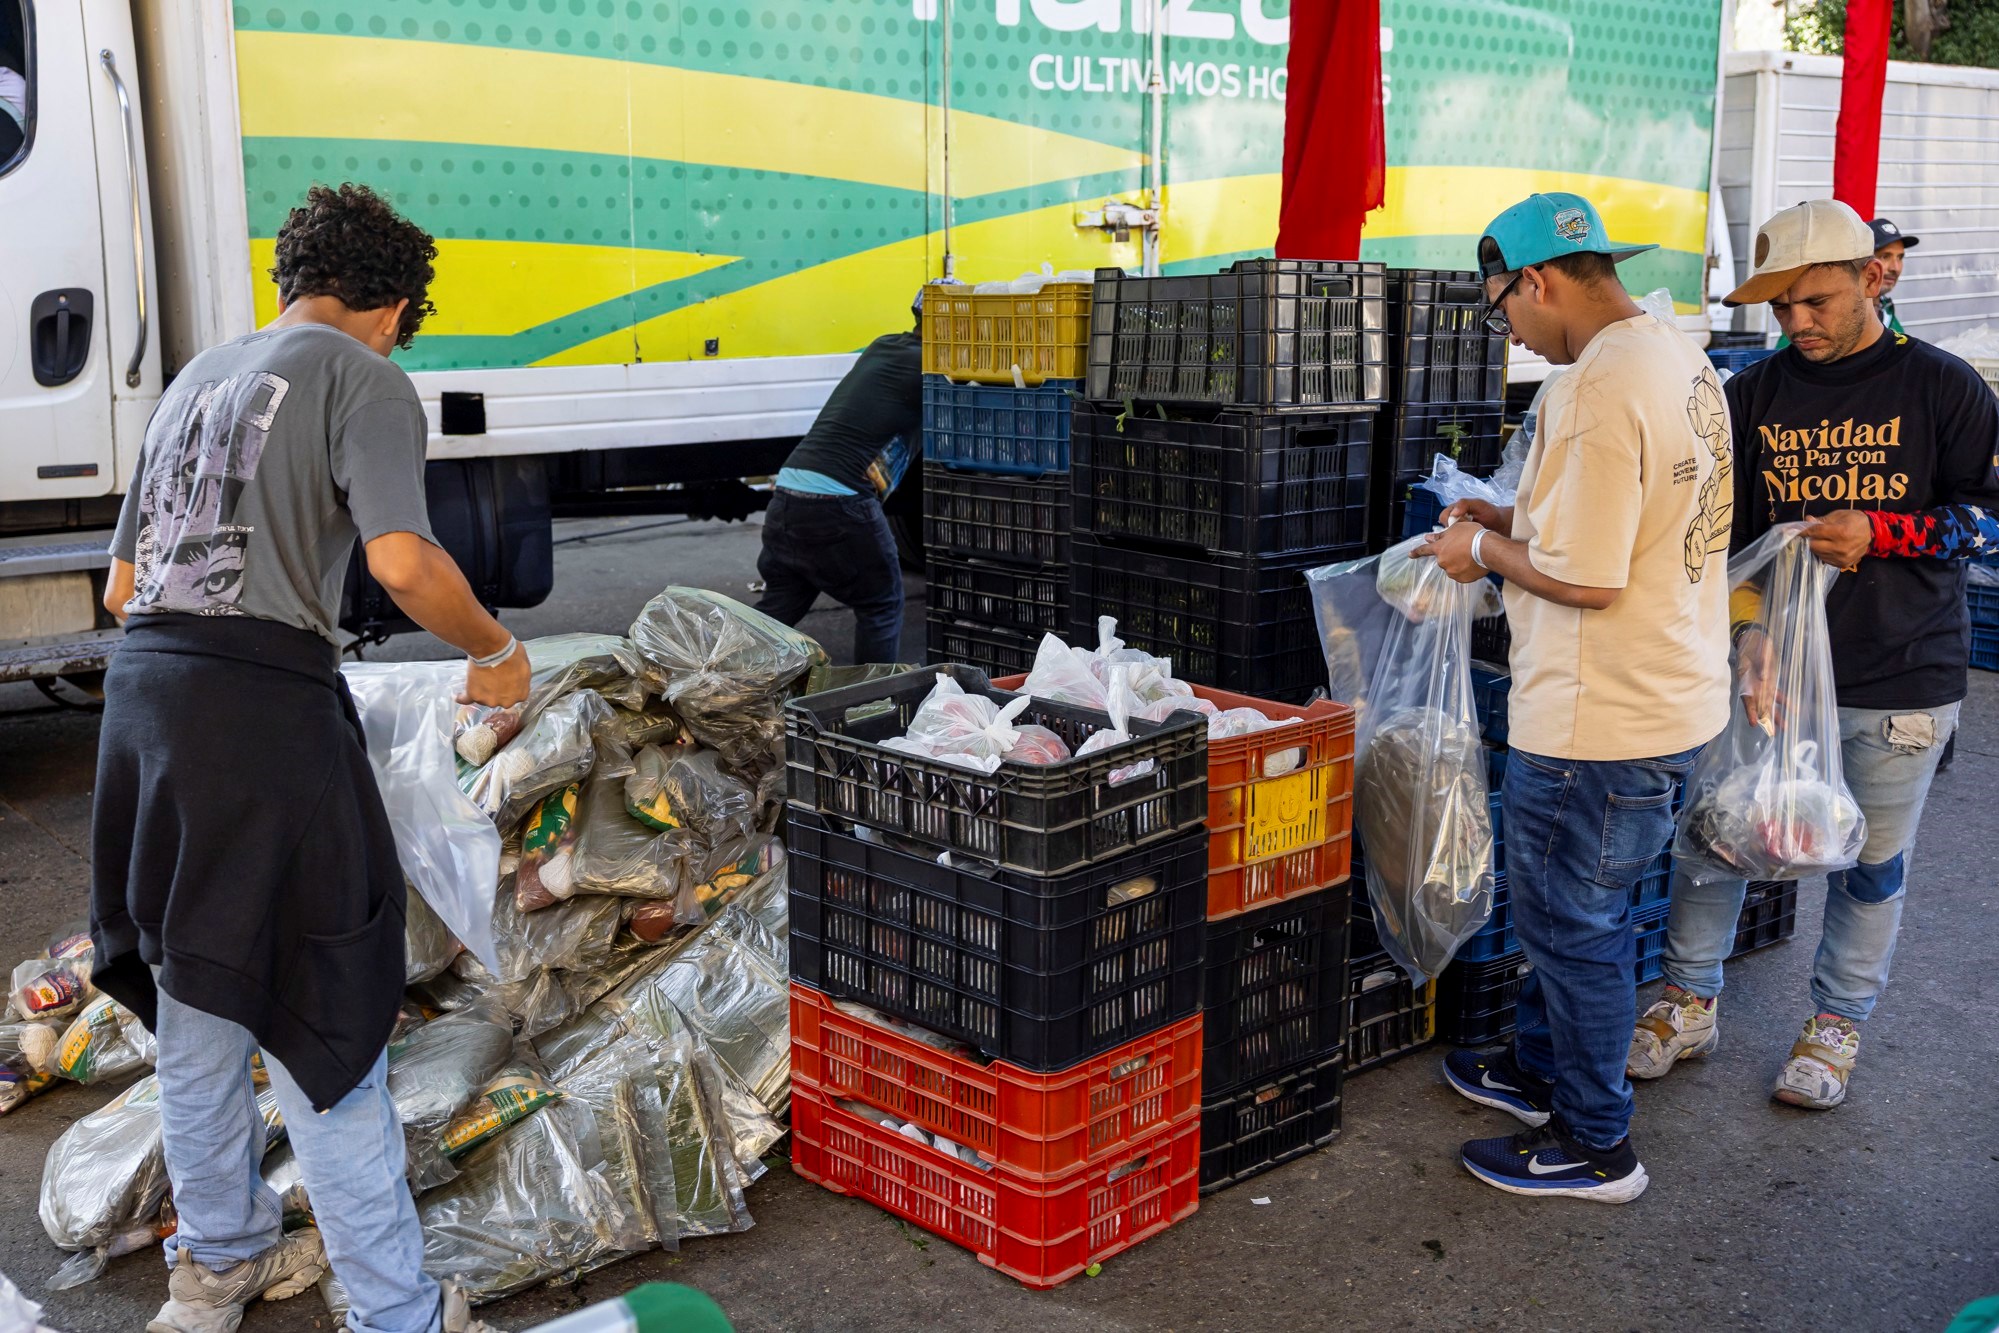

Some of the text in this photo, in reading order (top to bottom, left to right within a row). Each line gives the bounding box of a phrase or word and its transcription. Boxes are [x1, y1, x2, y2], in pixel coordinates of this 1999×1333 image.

[1029, 53, 1241, 98] CULTIVAMOS
[1758, 415, 1901, 454] Navidad
[1673, 457, 1697, 470] CREATE
[1773, 449, 1887, 469] en Paz con
[1673, 463, 1700, 478] MOVEME
[1673, 473, 1698, 486] FUTURE
[1761, 465, 1909, 503] Nicolas
